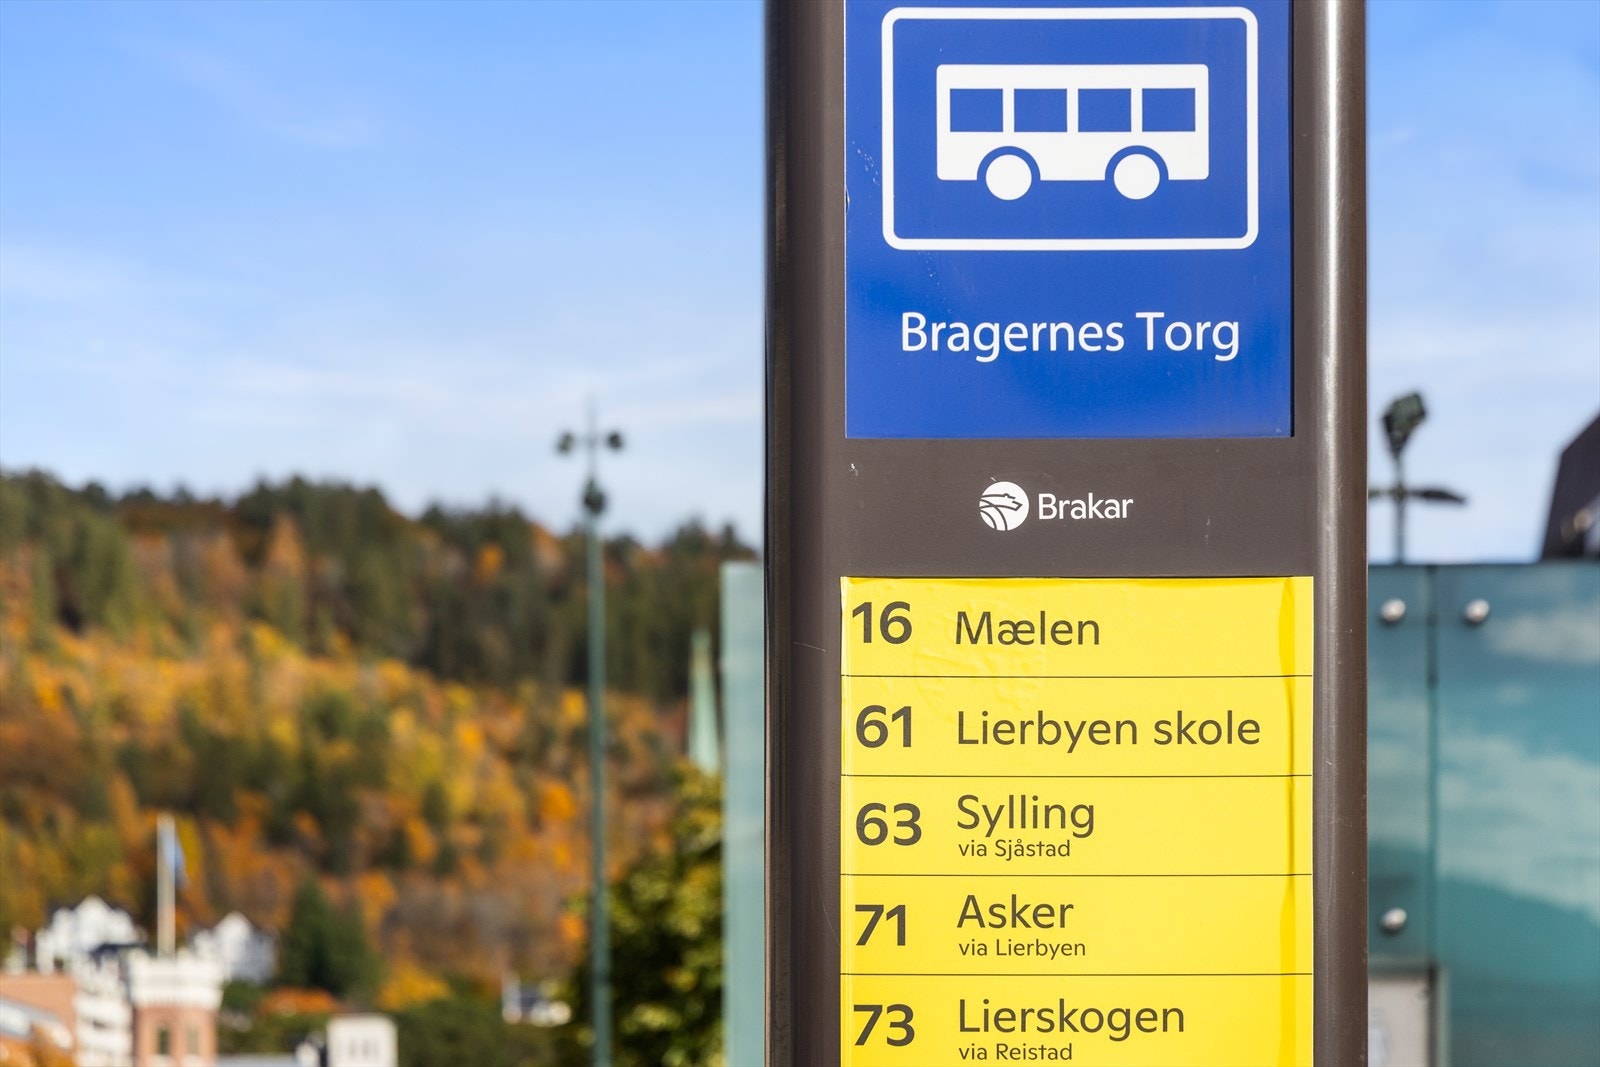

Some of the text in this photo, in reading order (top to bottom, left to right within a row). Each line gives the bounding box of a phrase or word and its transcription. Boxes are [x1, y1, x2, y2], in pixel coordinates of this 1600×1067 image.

[901, 312, 1239, 363] Bragernes Torg
[1038, 492, 1134, 520] Brakar
[852, 601, 1100, 646] 16 Mælen
[855, 704, 1260, 754] 61 Lierbyen skole
[855, 794, 1094, 846] 63 Sylling
[958, 838, 1071, 861] via Sjåstad
[855, 894, 1074, 946] 71 Asker
[958, 938, 1086, 960] via Lierbyen
[853, 998, 1184, 1047] 73 Lierskogen
[958, 1042, 1072, 1061] via Reistad
